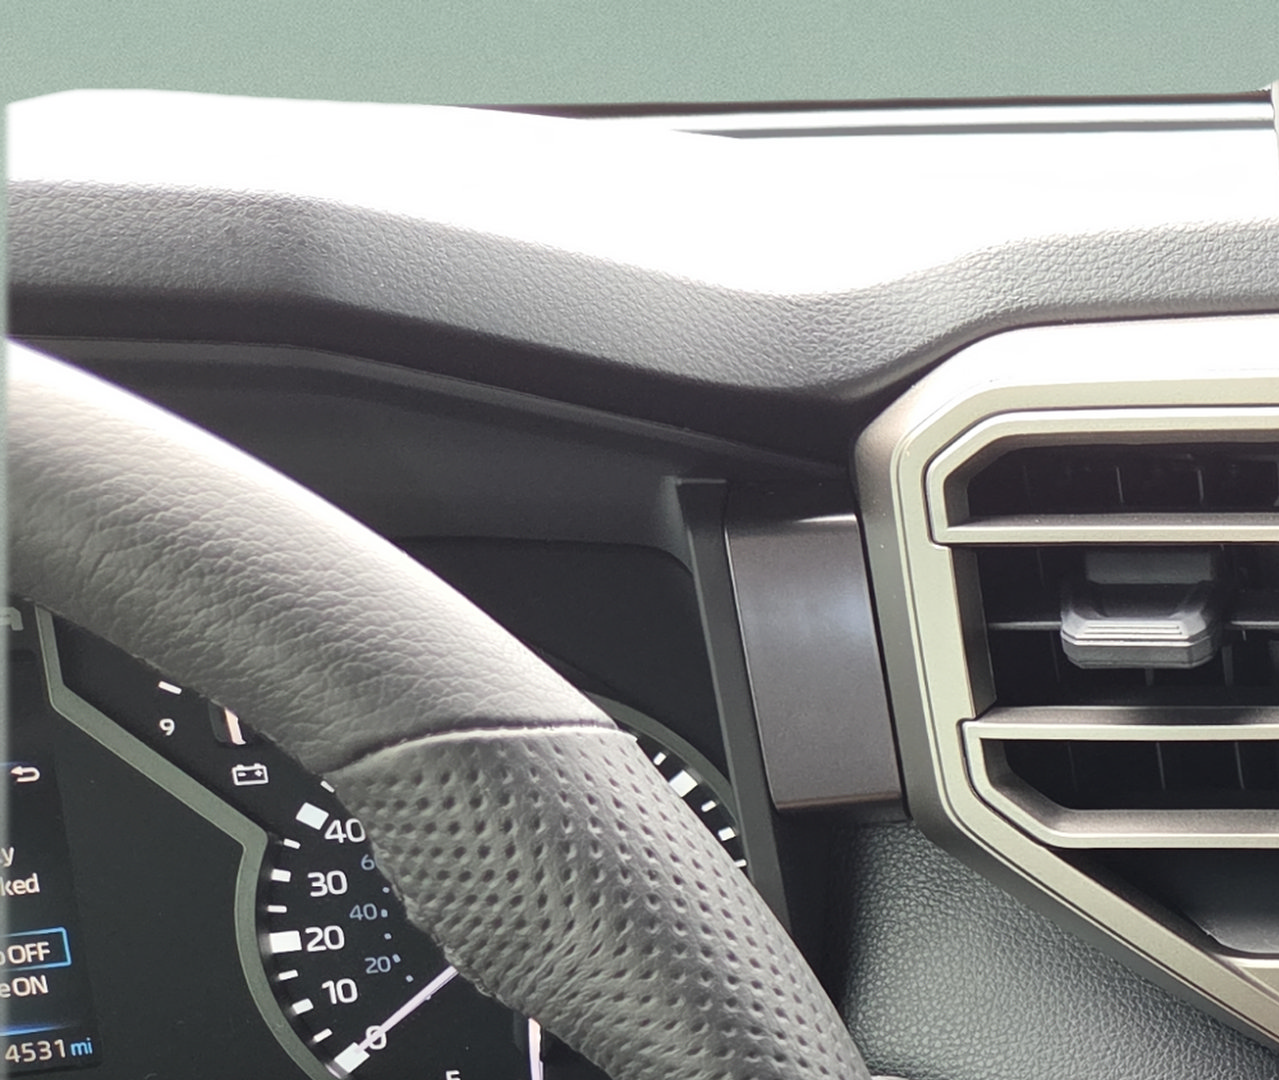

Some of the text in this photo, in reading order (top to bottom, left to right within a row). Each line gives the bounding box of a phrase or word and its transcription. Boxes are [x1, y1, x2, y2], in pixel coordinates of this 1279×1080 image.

[159, 718, 176, 736] 9
[324, 817, 367, 844] 40
[307, 869, 348, 897] 30
[349, 904, 377, 921] 40
[305, 925, 345, 951] 20
[365, 956, 392, 974] 20
[12, 974, 49, 998] ON
[321, 978, 358, 1004] 10
[5, 1037, 93, 1063] 4531 mi
[365, 1025, 388, 1050] 0
